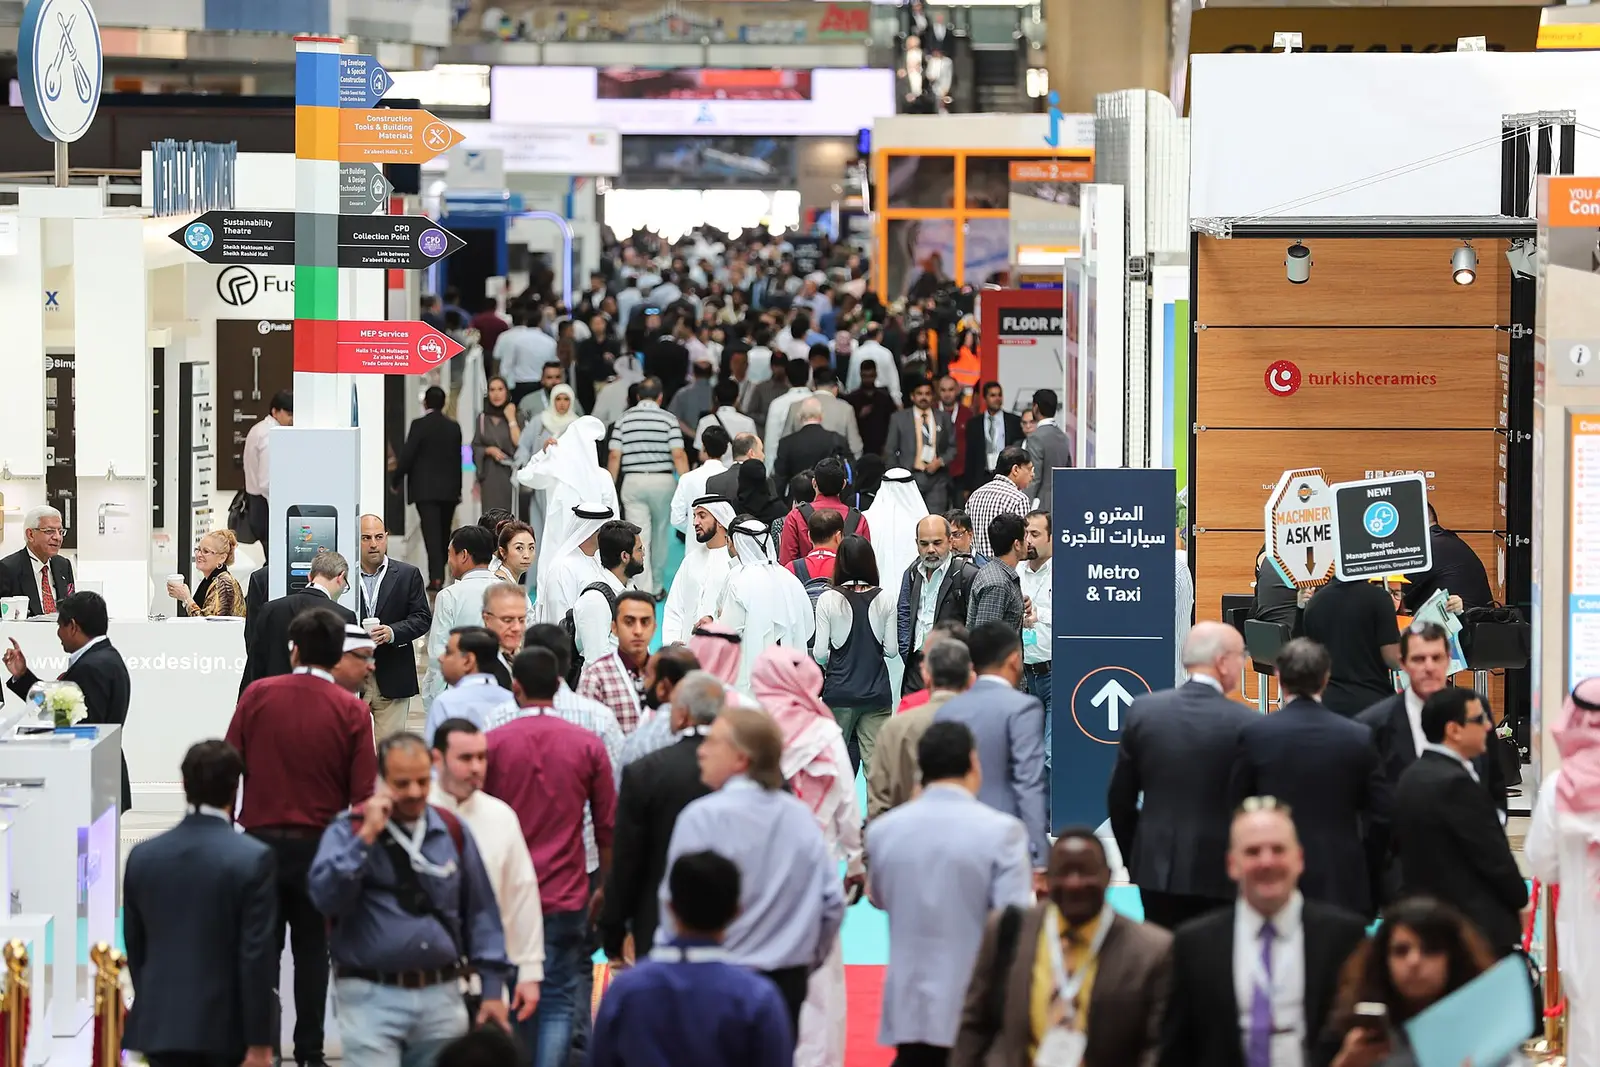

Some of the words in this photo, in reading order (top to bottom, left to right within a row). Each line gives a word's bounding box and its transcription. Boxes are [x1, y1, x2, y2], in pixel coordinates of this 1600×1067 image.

[383, 124, 412, 132] Building
[1569, 188, 1592, 200] YOU
[223, 219, 273, 228] Sustainability
[1003, 317, 1048, 331] FLOOR
[1308, 371, 1437, 385] turkishceramics
[1366, 487, 1392, 498] NEW!
[1084, 511, 1094, 524] و
[1099, 505, 1143, 525] المترو
[1062, 526, 1105, 547] الأجرة
[1109, 529, 1165, 548] سيارات
[1286, 526, 1311, 546] ASK
[1314, 524, 1331, 541] ME
[1371, 541, 1394, 550] Project
[1346, 551, 1386, 560] Management
[1386, 546, 1421, 555] Workshops
[1088, 564, 1140, 580] Metro
[1086, 586, 1100, 601] &
[1105, 587, 1141, 601] Taxi
